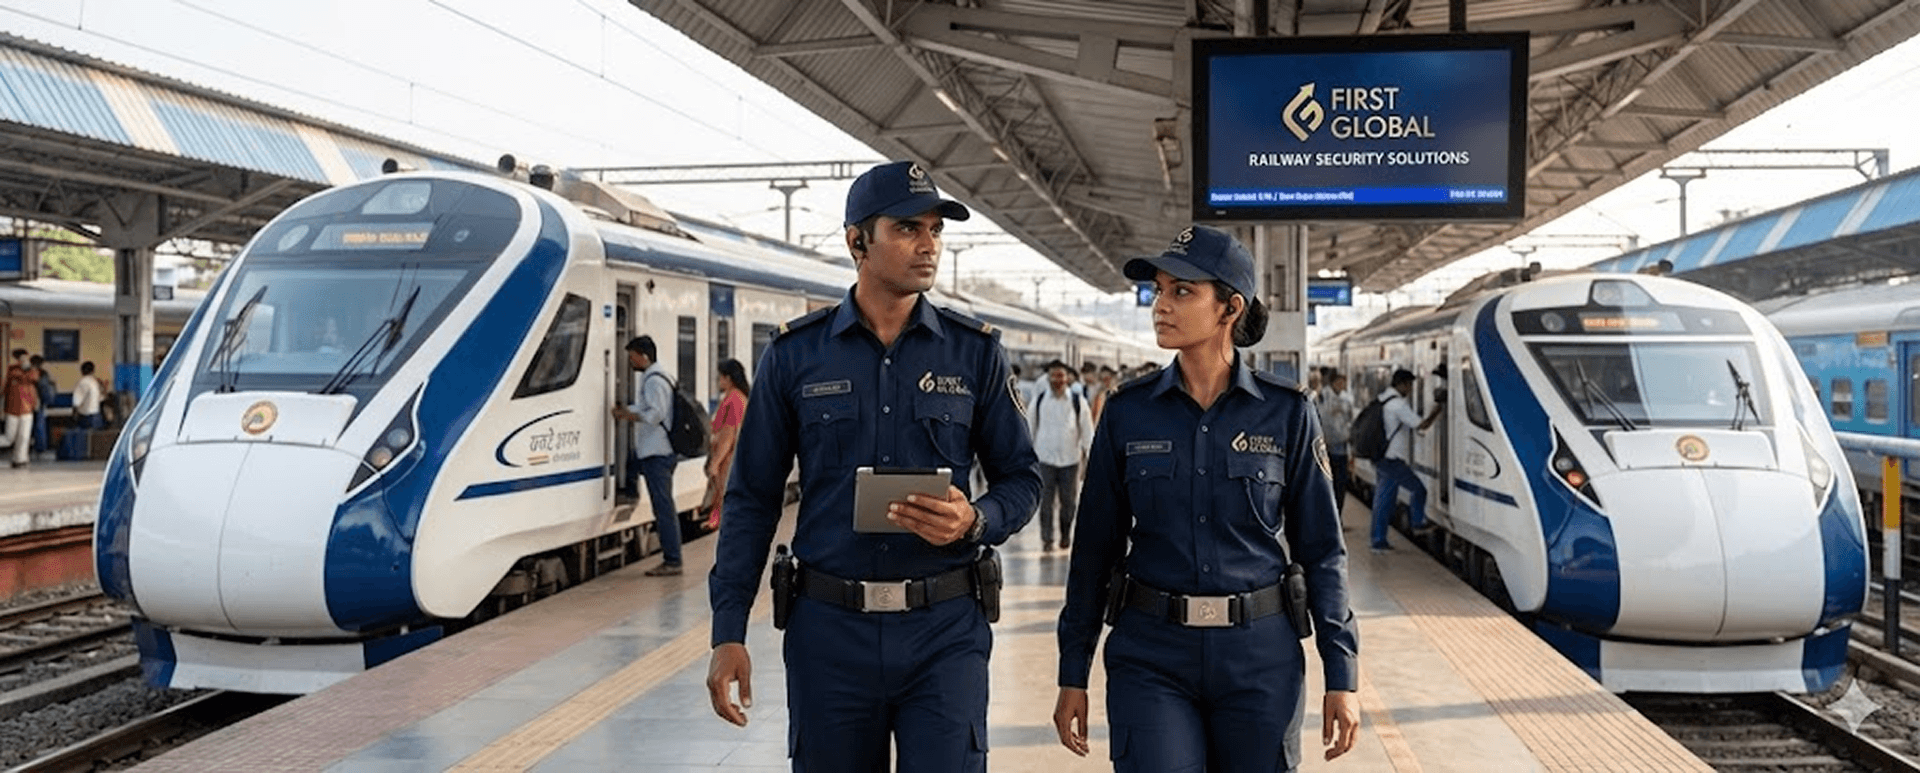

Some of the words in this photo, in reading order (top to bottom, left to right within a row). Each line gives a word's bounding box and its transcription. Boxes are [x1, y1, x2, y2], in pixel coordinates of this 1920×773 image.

[1331, 88, 1399, 110] FIRST
[1331, 116, 1435, 138] GLOBAL
[1249, 153, 1312, 166] RAILWAY
[1315, 152, 1384, 166] SECURITY
[1387, 151, 1470, 165] SOLUTIONS
